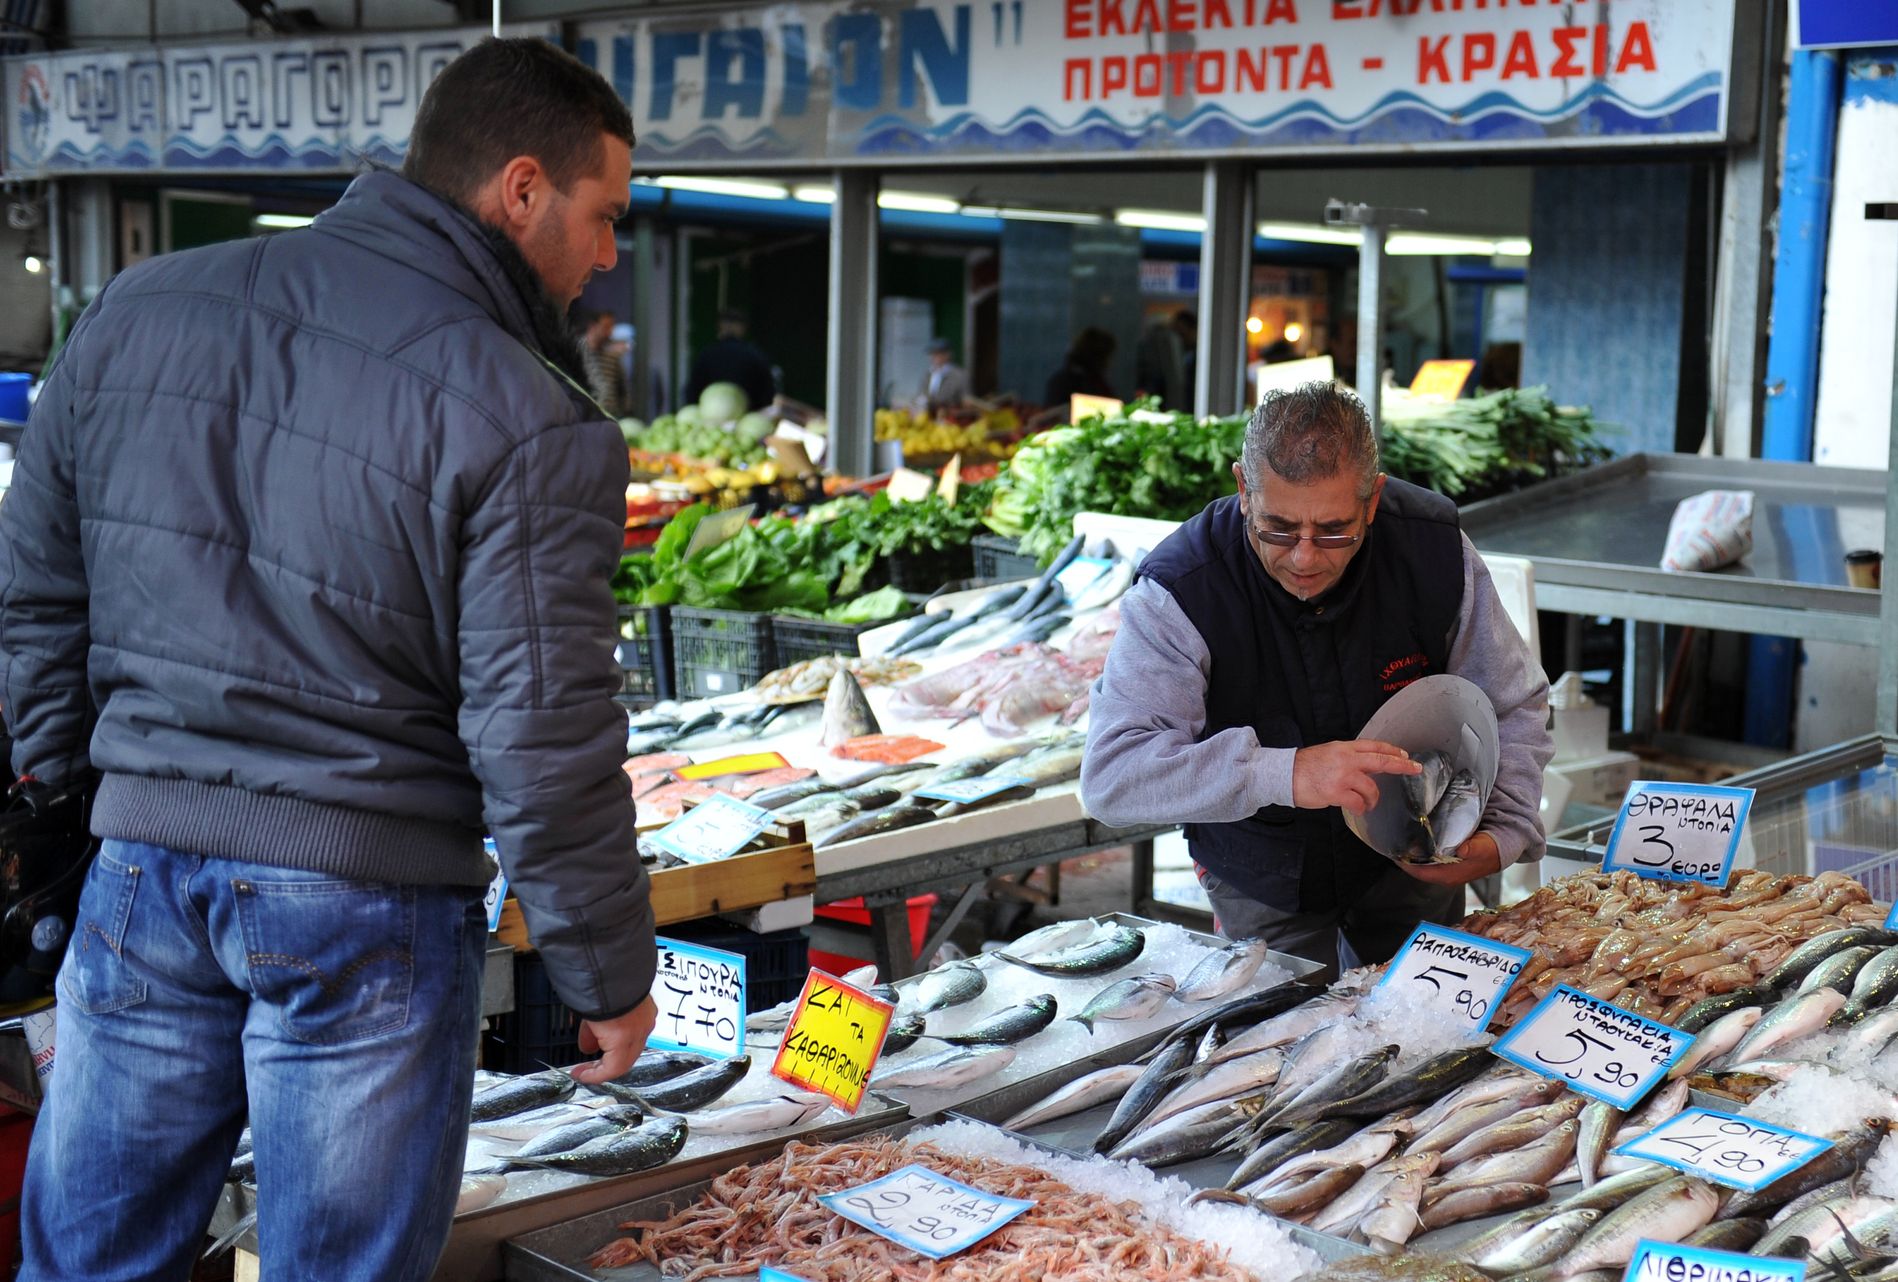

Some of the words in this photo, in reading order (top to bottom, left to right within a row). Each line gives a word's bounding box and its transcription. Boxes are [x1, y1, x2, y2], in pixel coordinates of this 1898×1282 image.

[1064, 43, 1334, 101] ΠΡΟΤΟΝΤΑ
[1416, 21, 1658, 85] ΚΡΑΣΙΑ
[1633, 825, 1674, 867] 3
[805, 976, 853, 1016] ΚΑΙ
[850, 1022, 864, 1044] ΤΑ
[1692, 1113, 1796, 1151] ΓΟΠΑ
[897, 1172, 1002, 1217] ΓΑΡΙΔΑ
